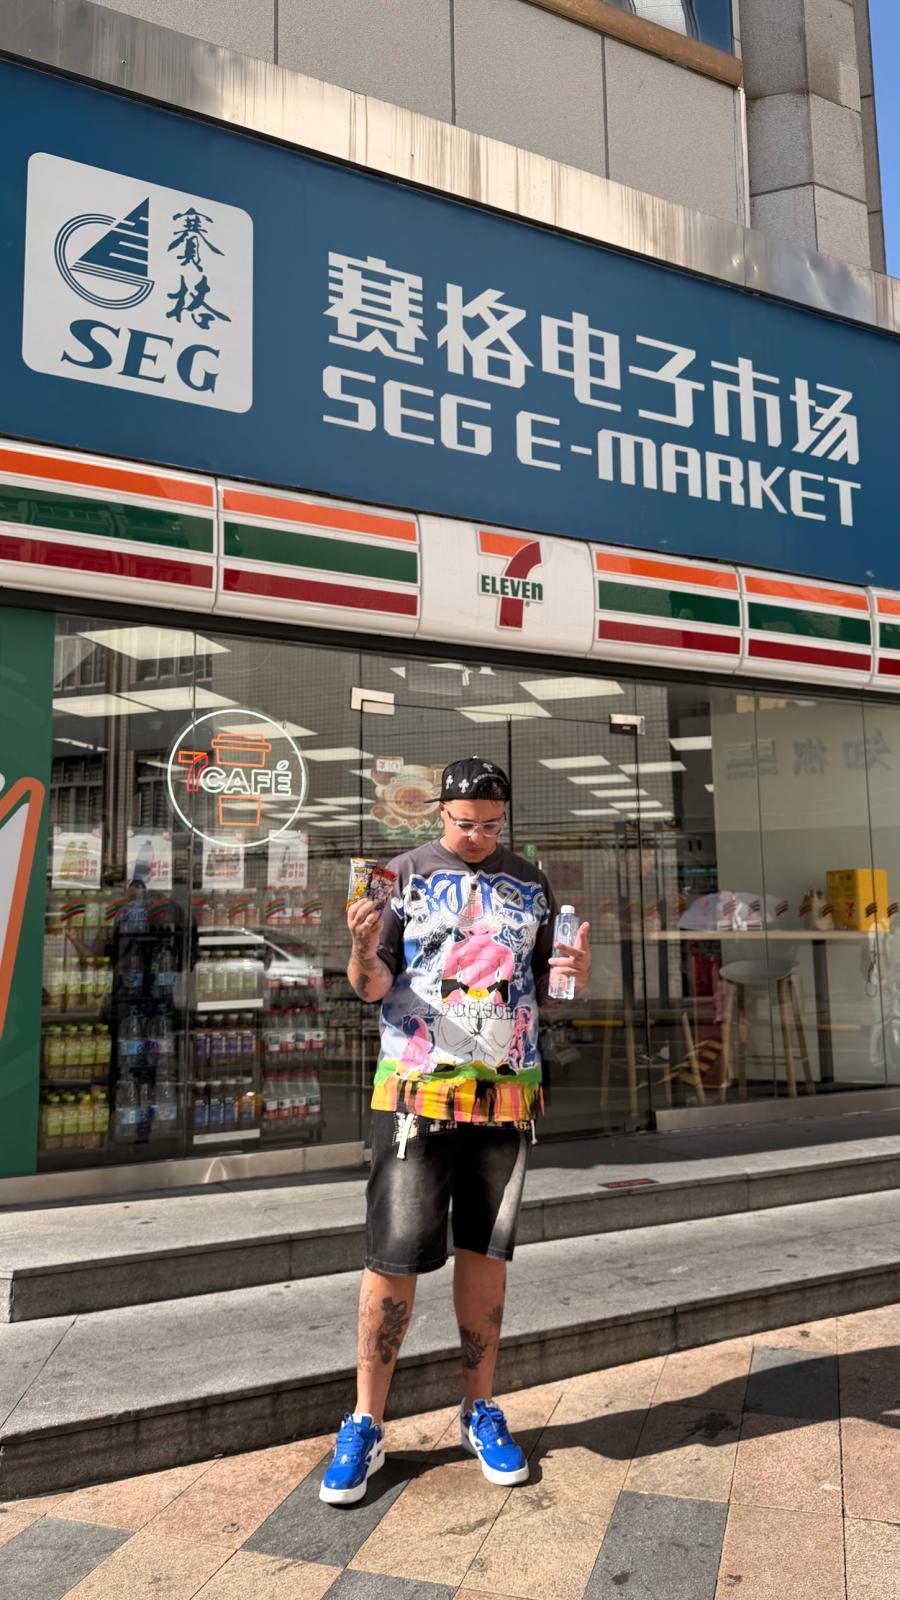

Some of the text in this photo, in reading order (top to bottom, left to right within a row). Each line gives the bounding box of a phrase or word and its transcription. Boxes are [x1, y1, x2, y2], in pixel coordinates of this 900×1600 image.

[60, 319, 221, 394] SEG
[323, 251, 860, 465] 赛格电子市场
[323, 365, 862, 527] SEG E-MARKET
[479, 531, 542, 628] 7
